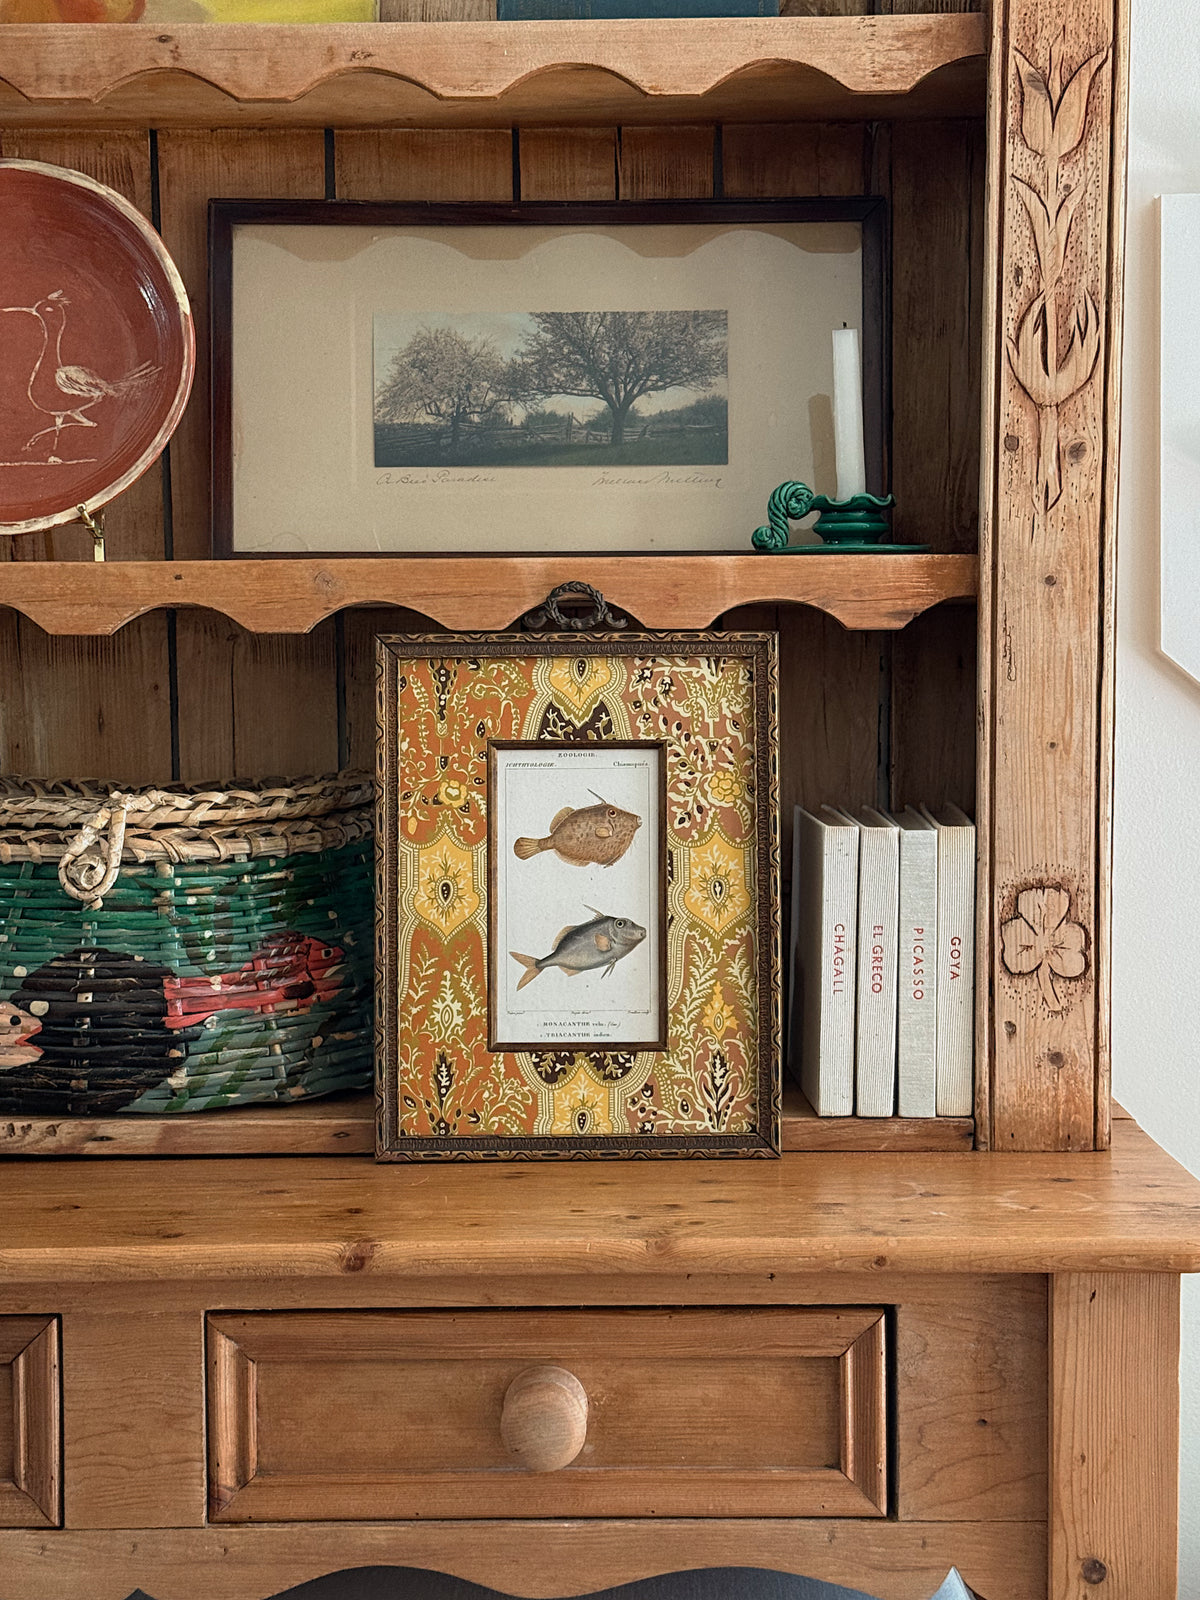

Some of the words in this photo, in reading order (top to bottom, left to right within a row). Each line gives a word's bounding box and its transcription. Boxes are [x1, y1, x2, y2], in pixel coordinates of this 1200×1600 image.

[873, 925, 883, 939] EL
[833, 923, 845, 995] CHAGALL
[871, 945, 883, 994] GRECO
[913, 927, 924, 1000] PICASSO
[949, 936, 961, 980] GOYA
